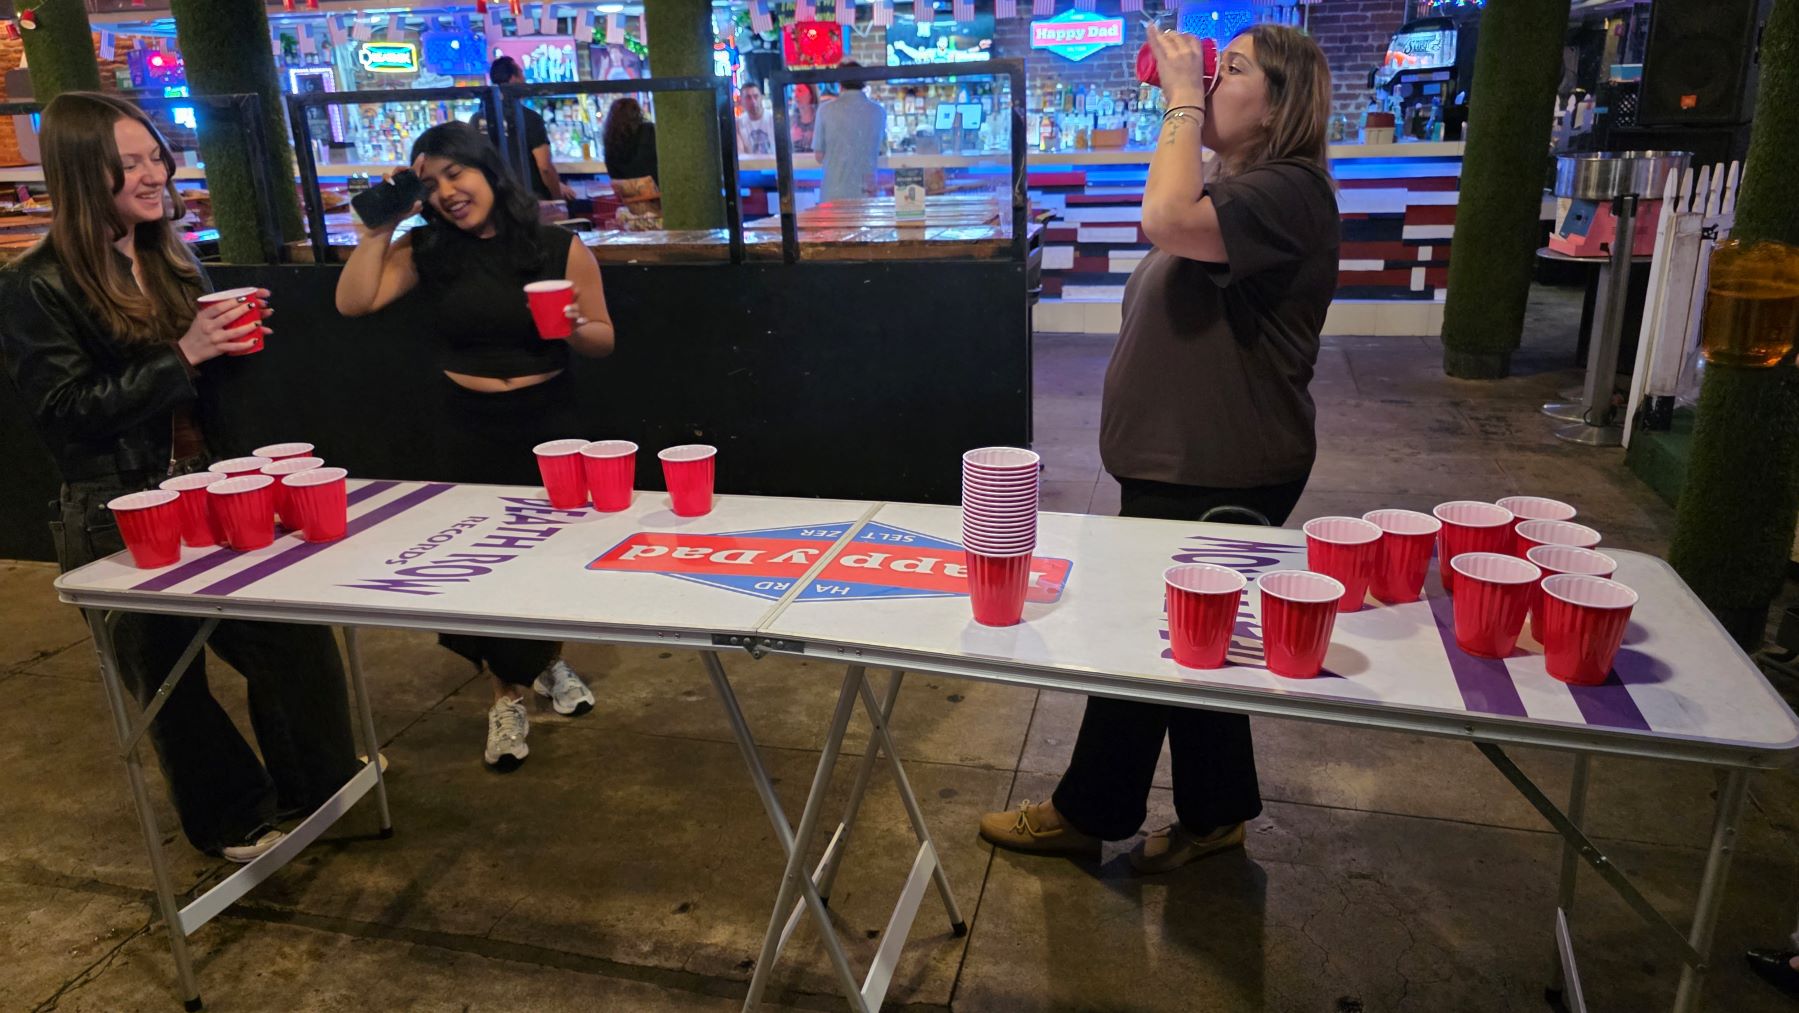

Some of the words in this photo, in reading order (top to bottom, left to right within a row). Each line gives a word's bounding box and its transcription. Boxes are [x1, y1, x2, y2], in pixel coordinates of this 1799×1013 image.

[1036, 27, 1085, 41] Happy
[1088, 24, 1118, 37] Dad
[384, 515, 489, 565] RECORDS
[617, 544, 766, 566] Dad
[1171, 535, 1308, 582] OW
[334, 553, 518, 596] ROW
